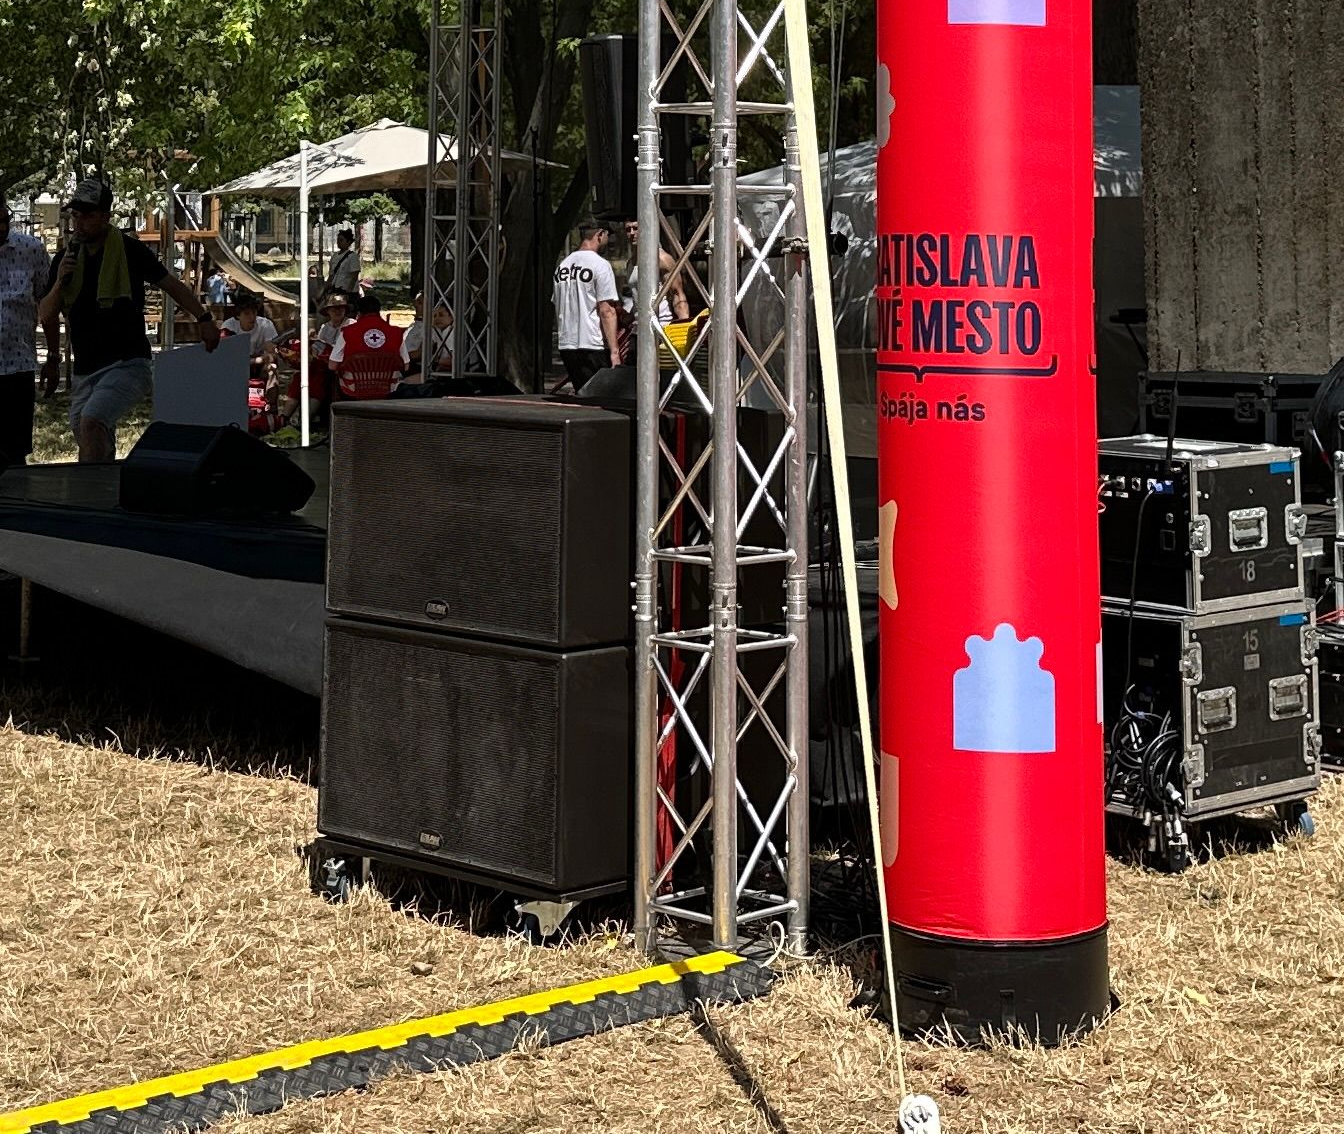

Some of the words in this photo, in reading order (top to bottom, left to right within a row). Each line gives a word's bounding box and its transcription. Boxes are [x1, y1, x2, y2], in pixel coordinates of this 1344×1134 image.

[912, 299, 1042, 355] MESTO
[880, 391, 928, 425] Spája
[936, 393, 986, 422] nás
[1238, 560, 1256, 582] 18
[1242, 629, 1259, 652] 15
